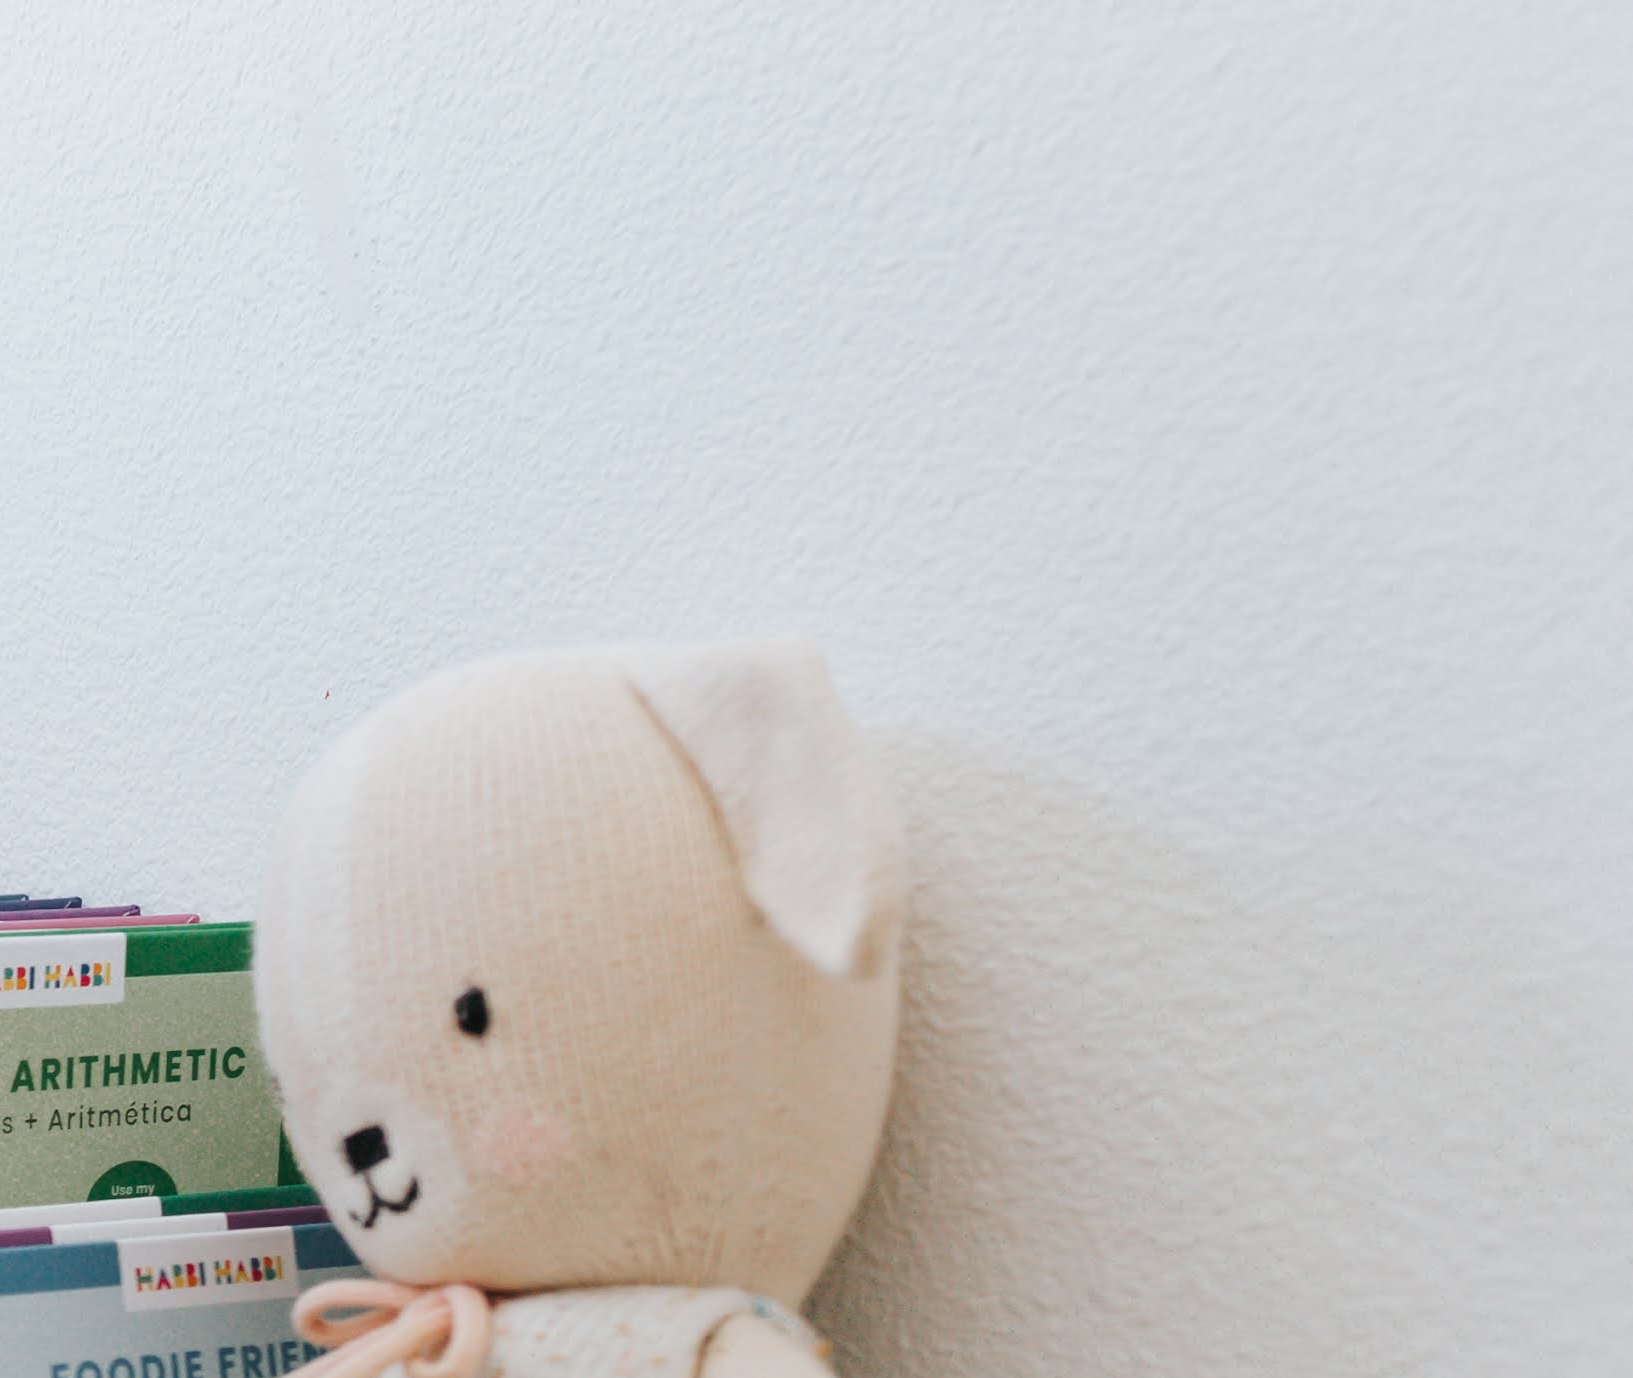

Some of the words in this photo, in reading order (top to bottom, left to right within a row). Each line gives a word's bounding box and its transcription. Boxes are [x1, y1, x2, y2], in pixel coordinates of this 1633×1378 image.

[43, 960, 111, 990] HABBI
[10, 1045, 247, 1094] ARITHMETIC
[25, 1112, 38, 1130] +
[47, 1100, 193, 1133] Aritmética
[111, 1185, 133, 1197] Use
[136, 1184, 155, 1197] my
[135, 1261, 206, 1293] HABBI
[214, 1254, 284, 1285] HABBI
